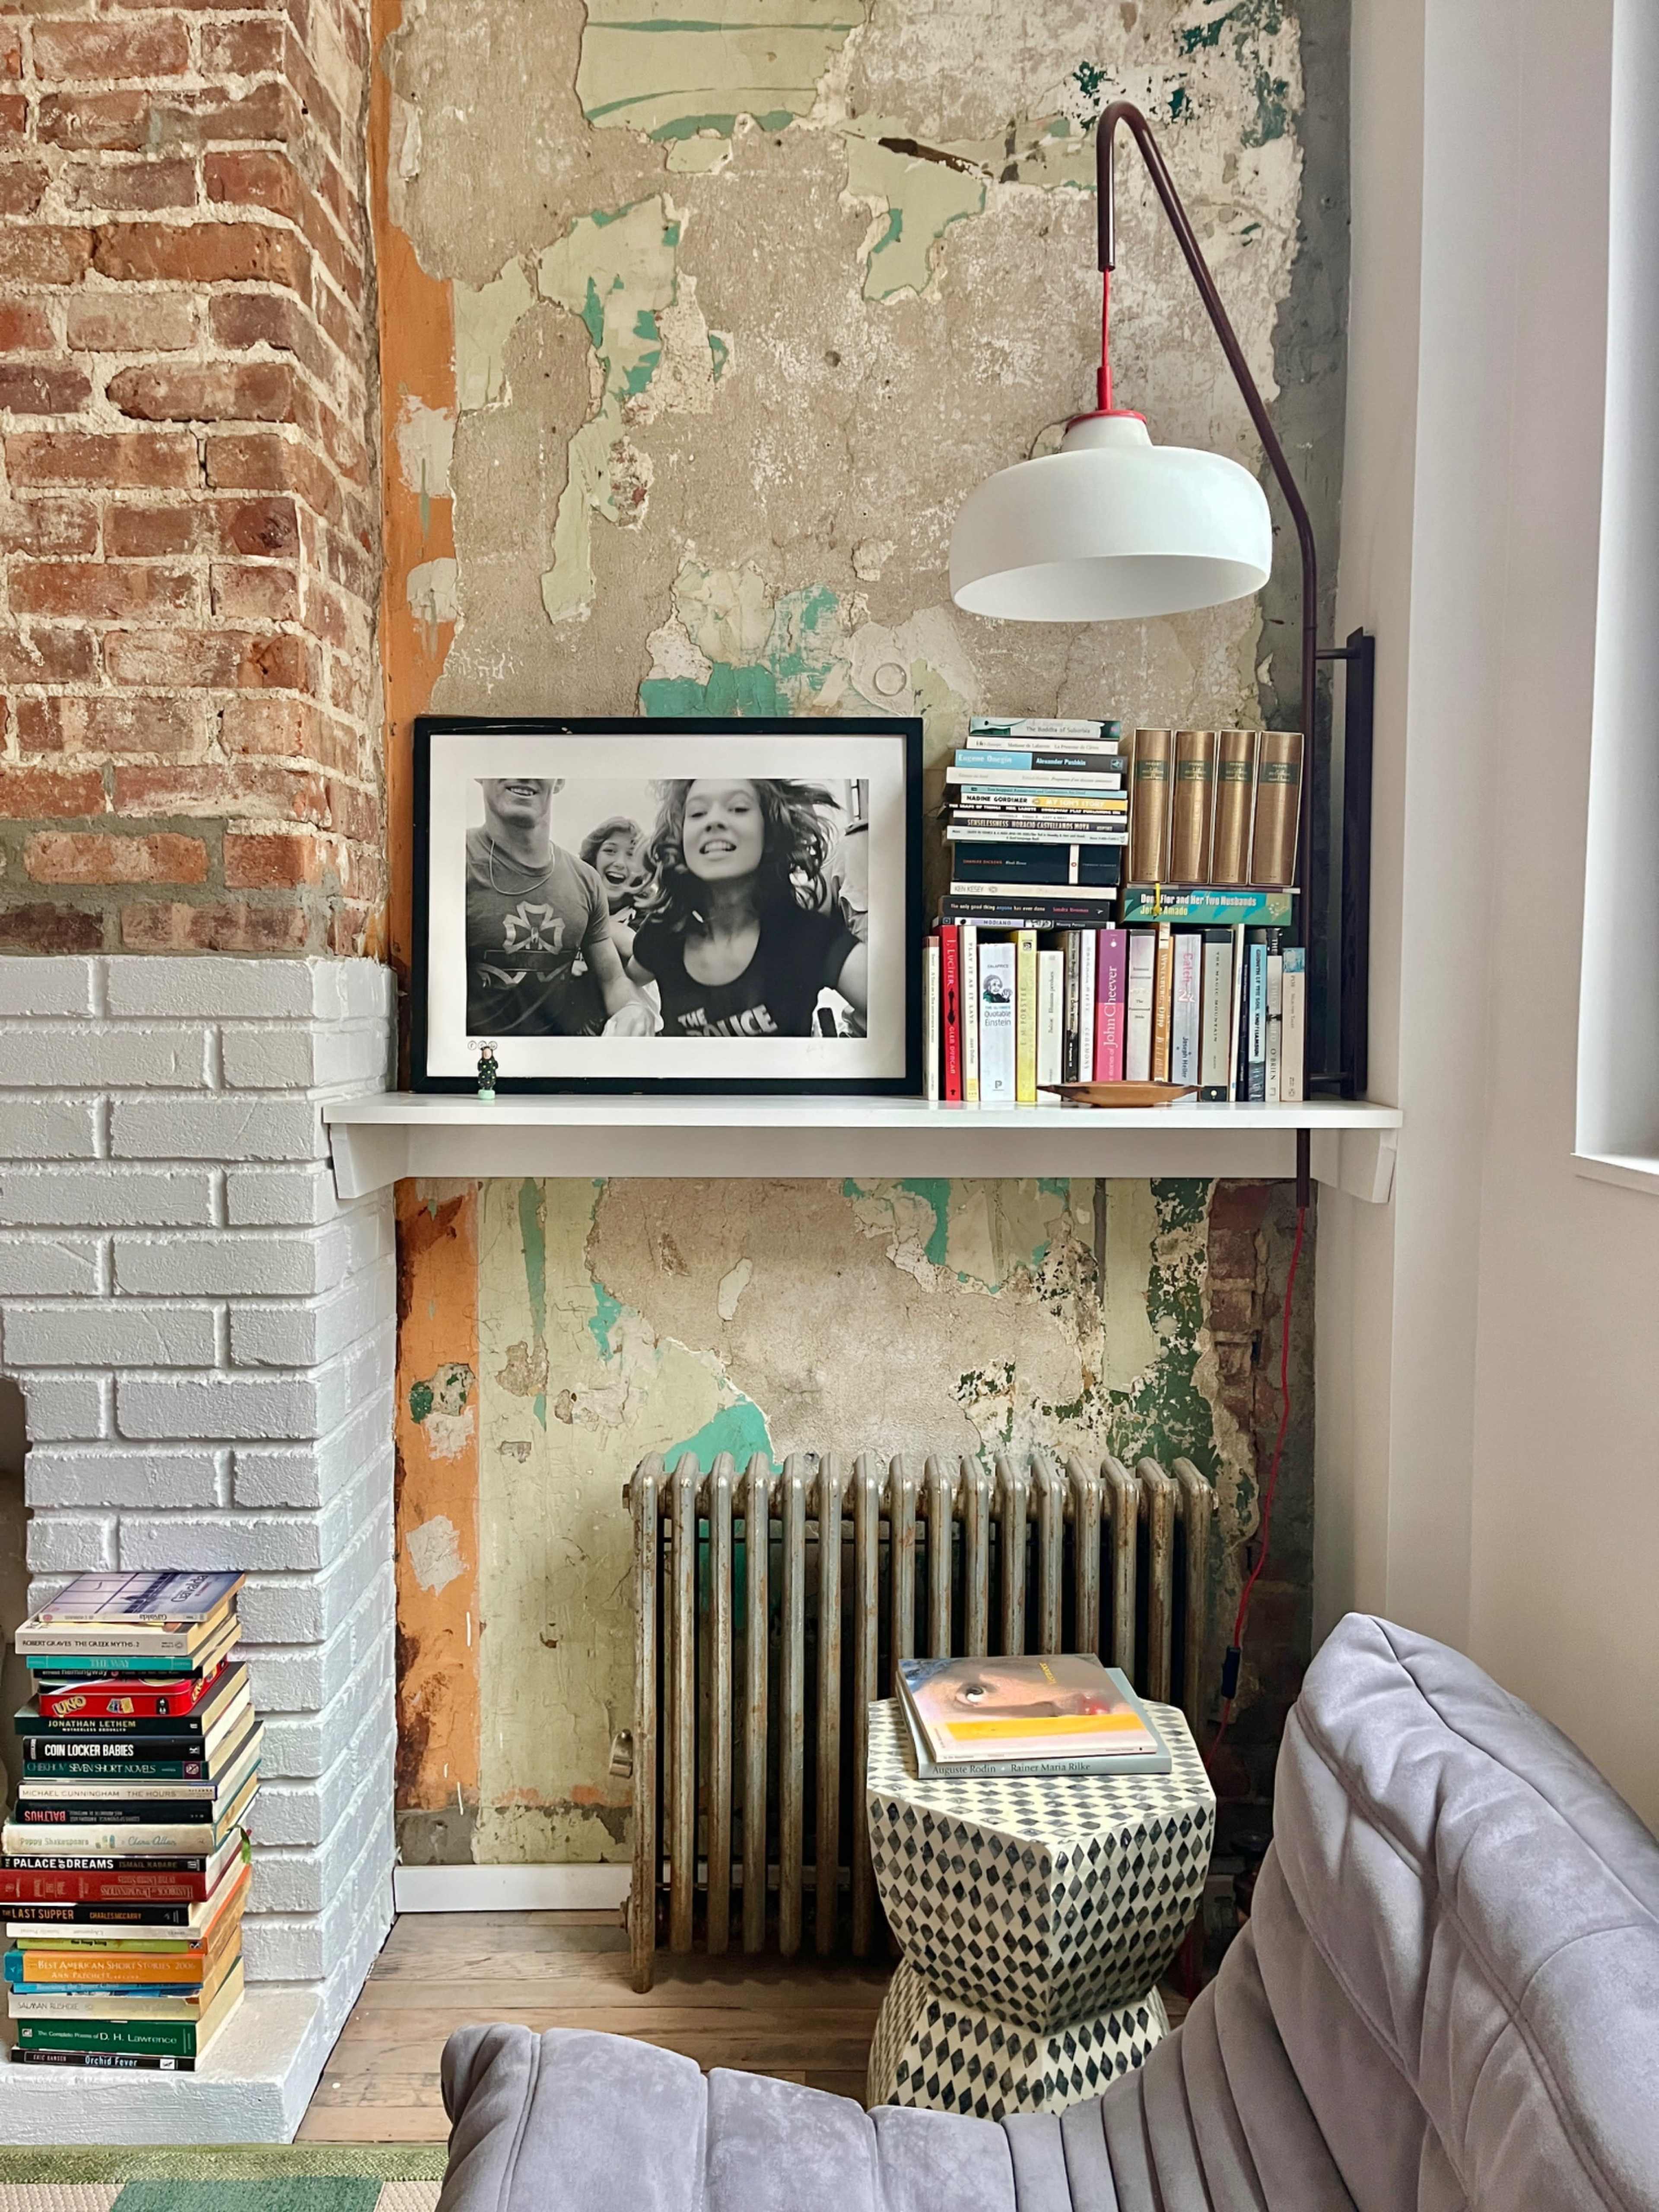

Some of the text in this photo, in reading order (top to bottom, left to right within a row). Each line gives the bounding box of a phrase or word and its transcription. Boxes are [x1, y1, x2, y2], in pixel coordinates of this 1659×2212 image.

[987, 755, 1012, 764] Onegin
[1141, 894, 1257, 906] Don Flor and Her Two Husbands
[1141, 906, 1188, 916] Jor Amado
[969, 979, 973, 988] AS
[1177, 953, 1195, 1003] Catch-22
[1104, 966, 1117, 1017] Cheever
[678, 1007, 708, 1028] THE
[686, 1004, 778, 1037] LICE
[1103, 1018, 1117, 1048] John
[171, 1575, 209, 1602] Gavalda
[89, 1658, 129, 1667] THE WAY
[52, 1696, 86, 1715] UNO
[44, 1744, 65, 1756] COIN
[67, 1744, 101, 1756] LOCKER
[102, 1744, 134, 1756] BABIES
[27, 1763, 156, 1773] CHEKHOV SEVEN SHORT NOVELS
[932, 1764, 996, 1776] Auguste Rodin
[1011, 1762, 1091, 1772] Rainer Maria Rilke
[24, 1810, 66, 1821] BALTHUS
[44, 1837, 89, 1846] Shakespeare
[13, 1859, 57, 1868] PALACE
[58, 1859, 66, 1869] OF
[67, 1859, 114, 1869] DREAMS
[12, 1909, 35, 1919] LAST
[38, 1909, 74, 1920] SUPPER
[38, 1961, 56, 1970] BEST
[60, 1961, 104, 1970] AMERICAN
[107, 1961, 135, 1970] SHORT
[138, 1961, 171, 1970] STORIES
[99, 2032, 110, 2040] D.
[127, 2034, 178, 2044] Lawrence
[85, 2056, 111, 2066] Orchid
[114, 2057, 138, 2067] Fever
